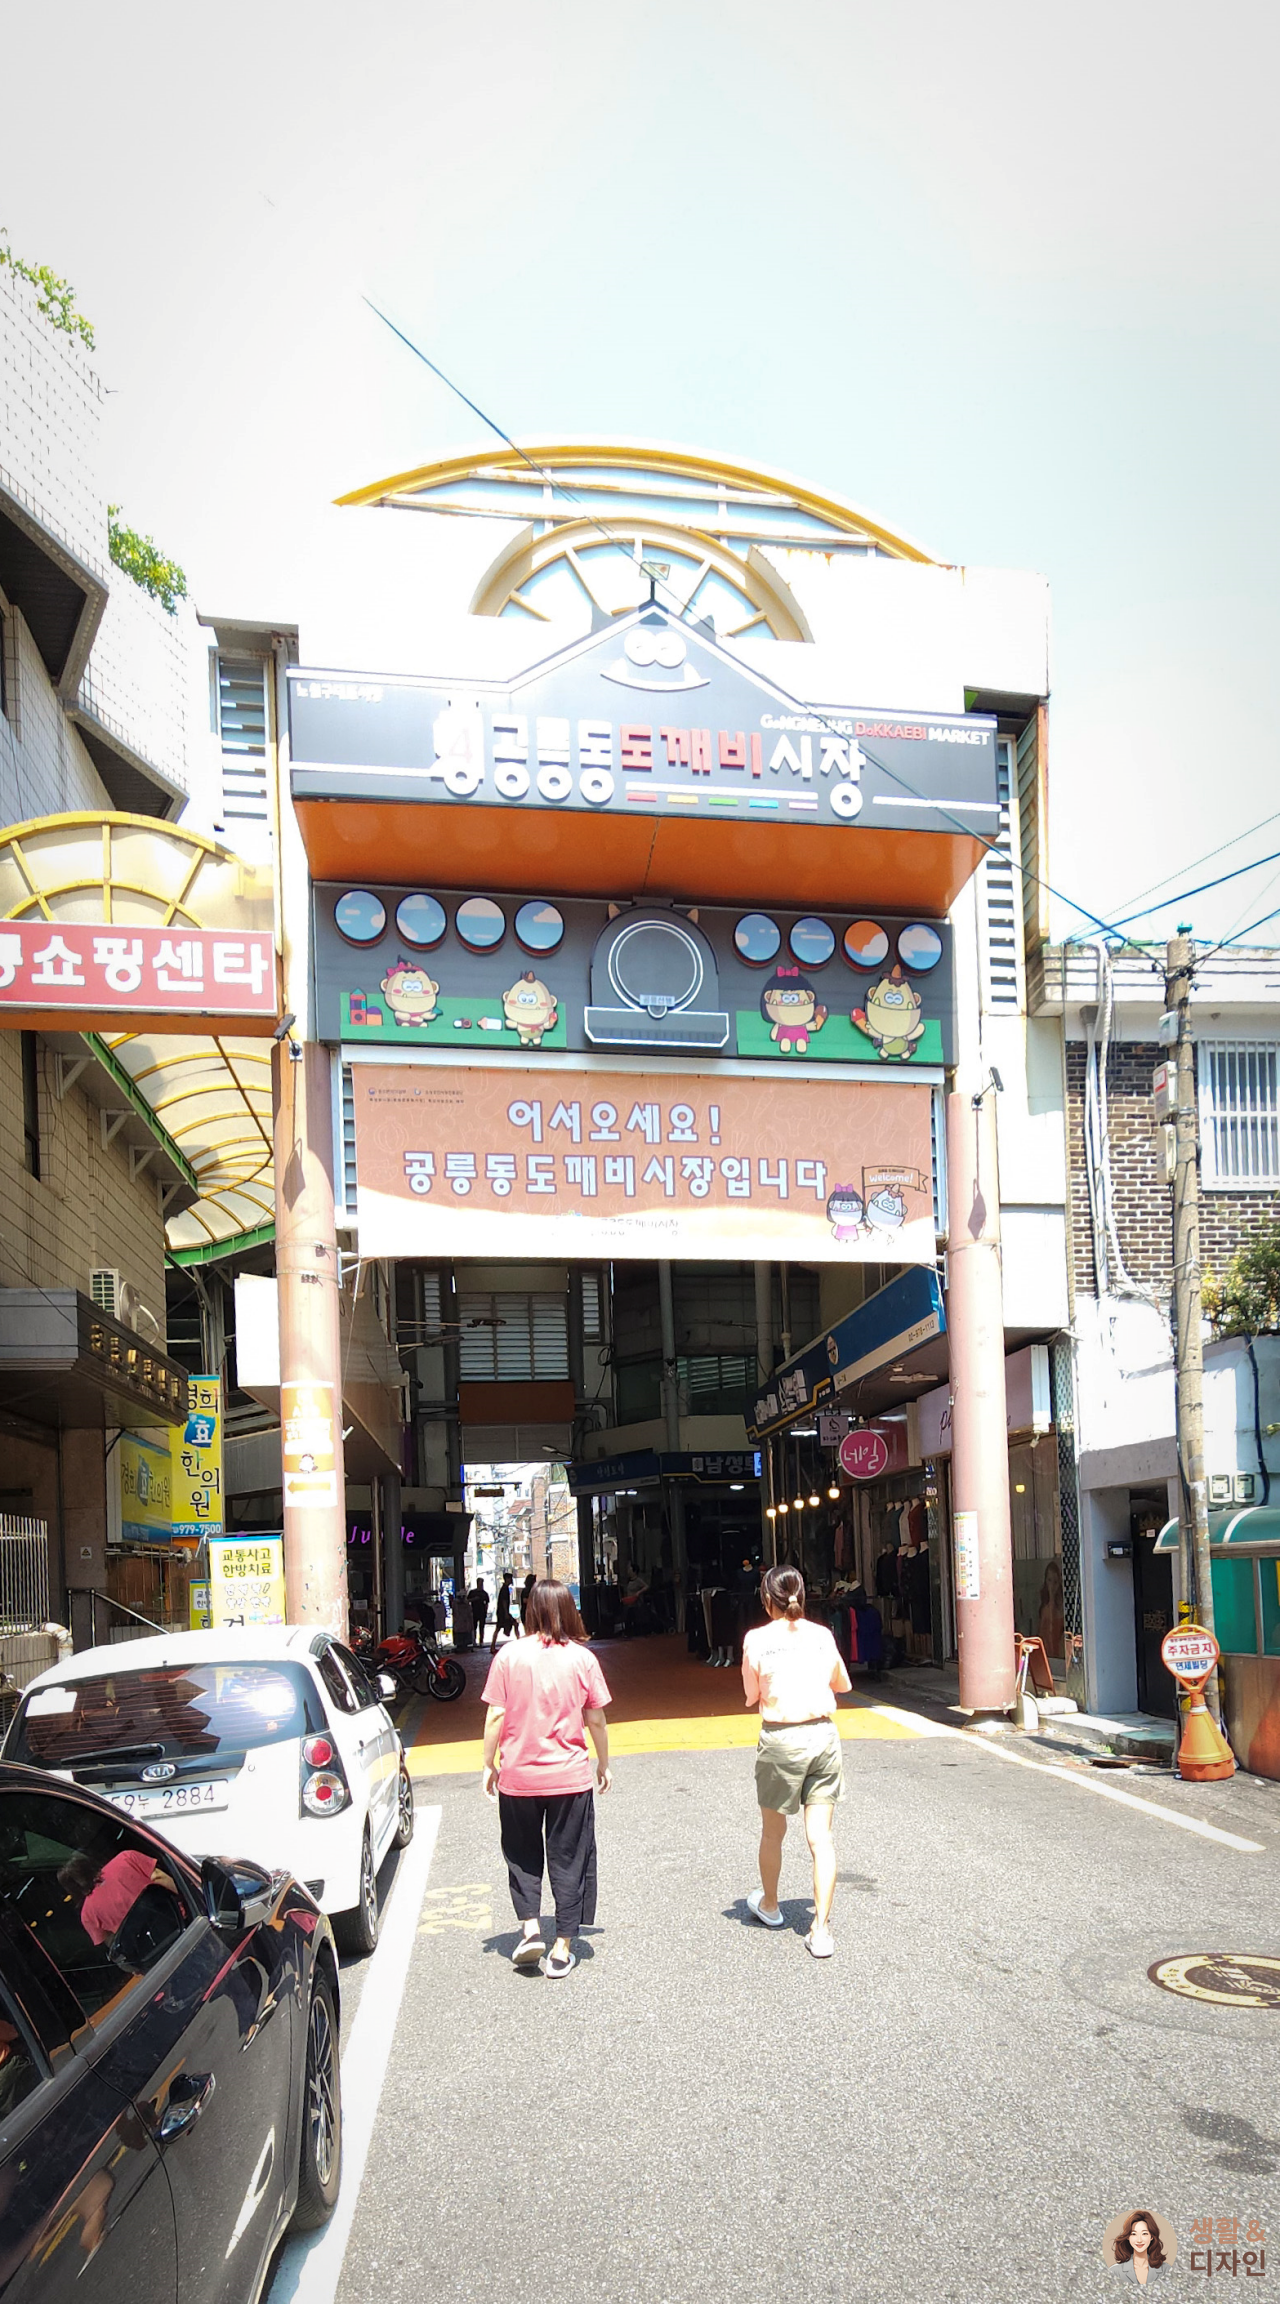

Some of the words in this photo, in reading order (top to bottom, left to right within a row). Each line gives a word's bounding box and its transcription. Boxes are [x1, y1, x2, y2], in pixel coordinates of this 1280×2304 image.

[928, 727, 991, 746] MARKET
[507, 1099, 721, 1146] 어서오세요!
[403, 1150, 827, 1200] 공릉동도깨비시장입니다
[843, 1438, 880, 1471] 네일
[178, 1523, 221, 1534] 979-7500
[347, 1525, 415, 1544] Jule
[222, 1547, 272, 1563] 교통사고
[222, 1562, 272, 1578] 한방치료
[148, 1767, 171, 1778] KIA
[162, 1784, 215, 1810] 2884
